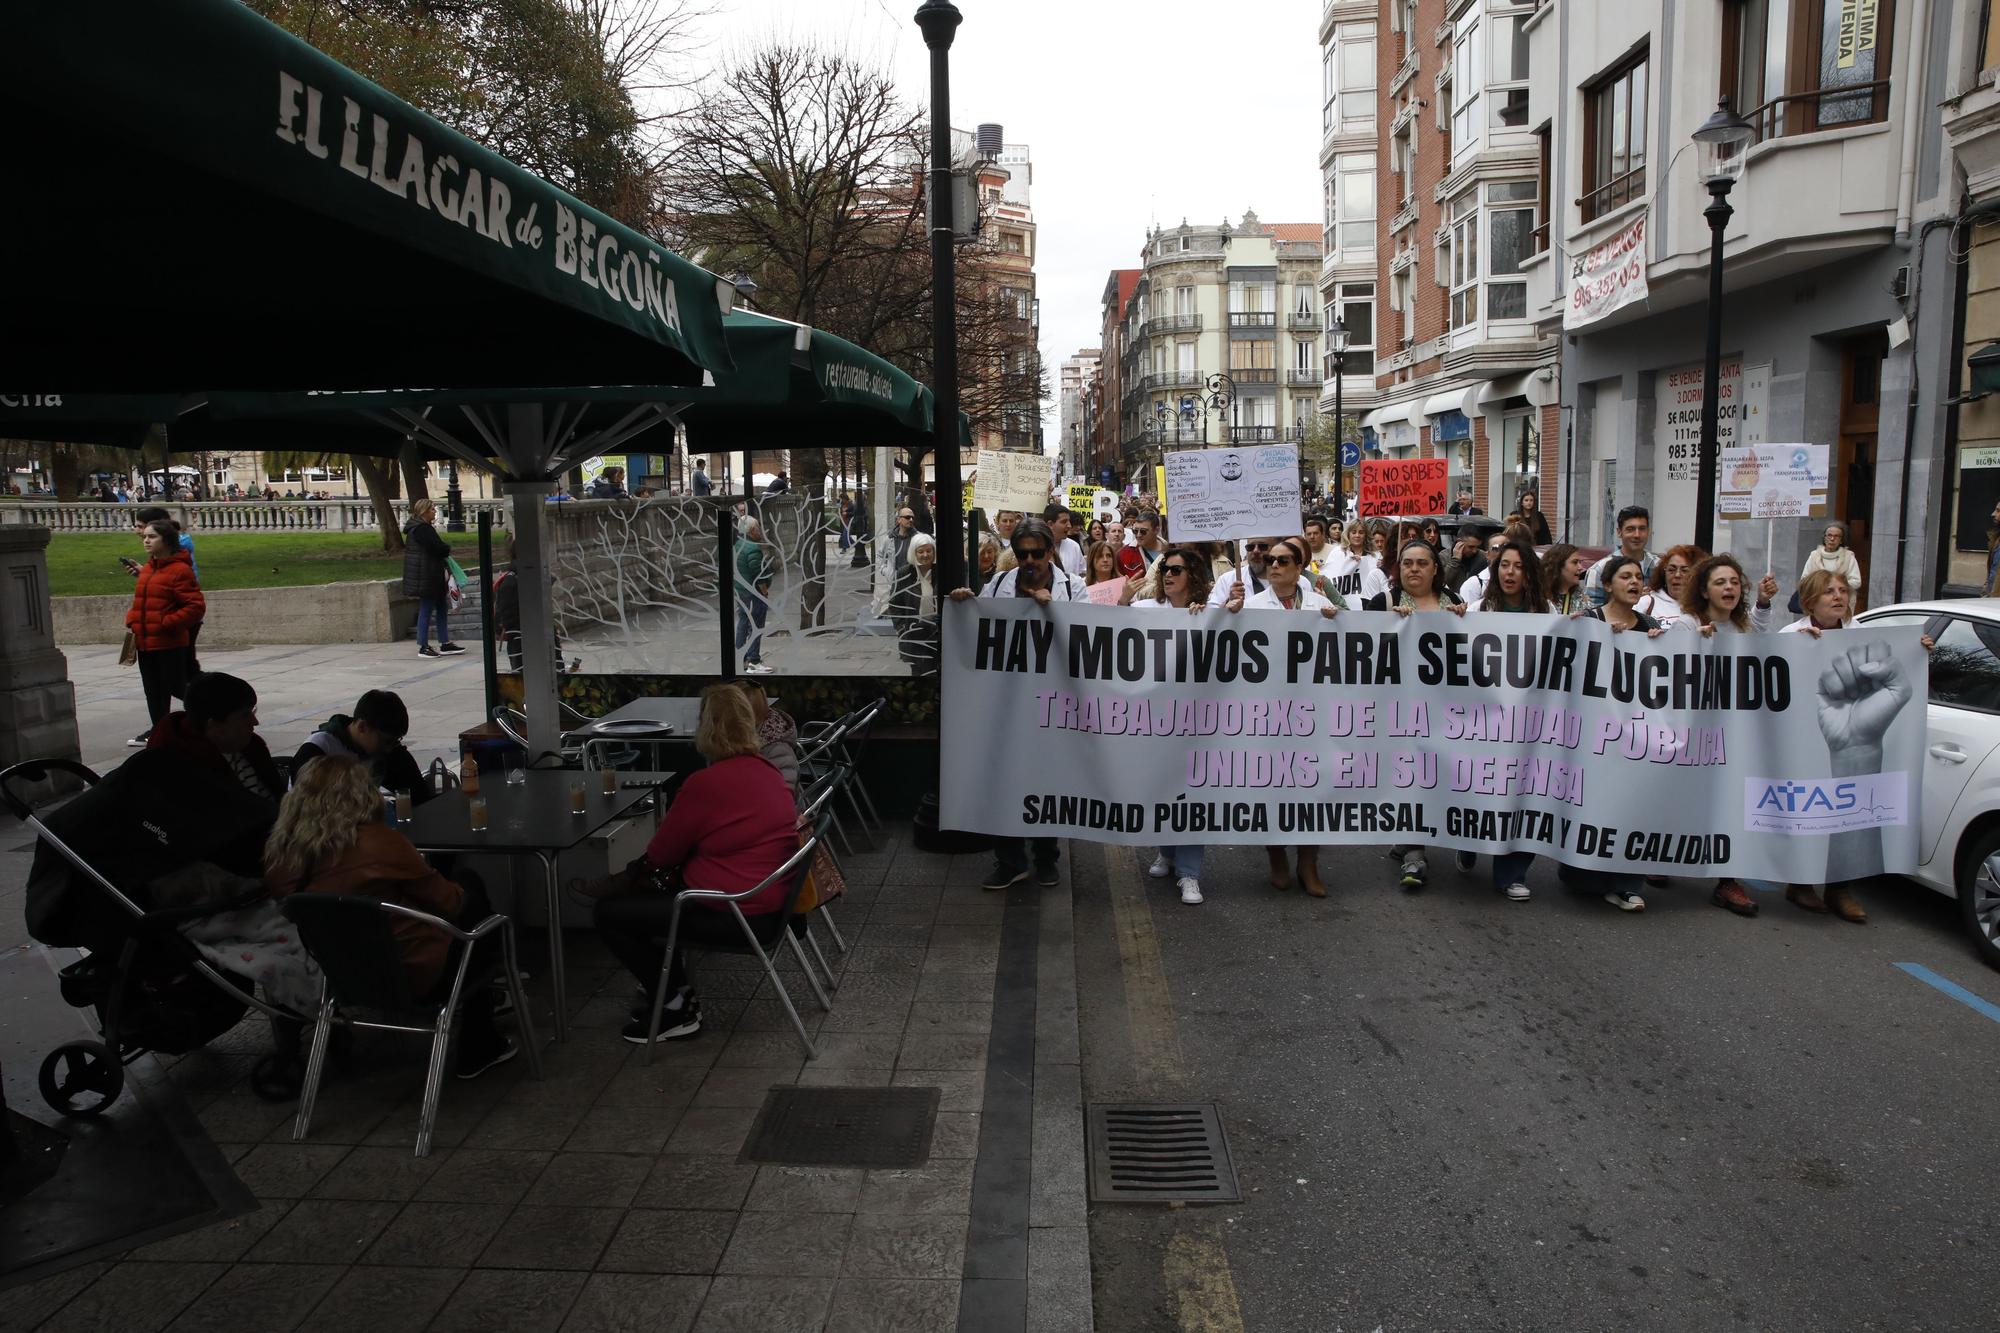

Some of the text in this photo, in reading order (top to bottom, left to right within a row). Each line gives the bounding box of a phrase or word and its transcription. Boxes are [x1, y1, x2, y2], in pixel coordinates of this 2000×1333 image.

[1859, 0, 1875, 49] TIMA
[275, 71, 683, 336] EL LLAGAR de BEGOÑA
[1669, 374, 1679, 388] SE
[1680, 369, 1702, 386] VENDE
[1677, 391, 1681, 404] 3
[1668, 412, 1677, 425] SE
[1668, 444, 1687, 459] 985
[1382, 467, 1398, 482] NO
[1402, 462, 1444, 481] SABES
[1668, 472, 1688, 480] FRESNO
[1363, 482, 1427, 500] MANDAR,
[1402, 500, 1420, 514] HAS
[1758, 500, 1802, 508] CONCILIACIÓN
[975, 617, 1791, 712] HAY MOTIVOS PARA SEGUIR LUCHANDO
[1036, 688, 1727, 767] TRABAJADORXS DE LA SANIDAD PÚBLICA
[1187, 749, 1585, 807] UNIDXS EN SU DEFENSA
[1756, 780, 1857, 812] ATAS
[1022, 793, 1731, 866] SANIDAD PÚBLICA UNIVERSAL, GRATUITA Y DE CALIDAD
